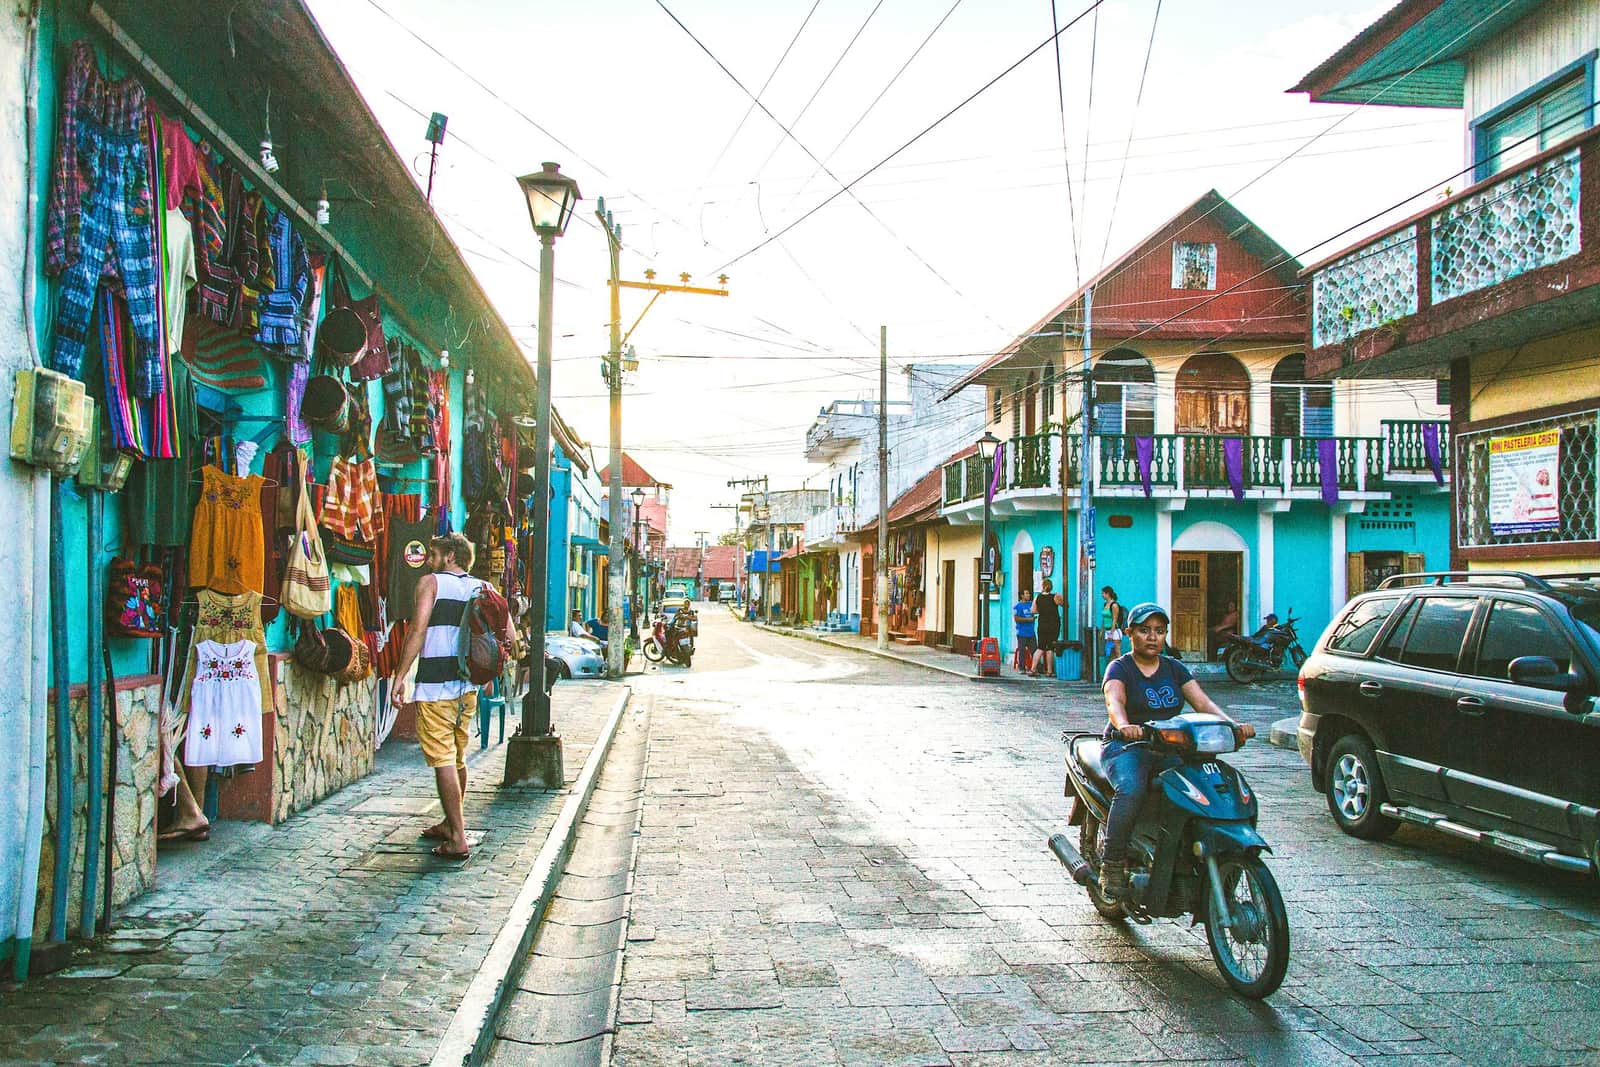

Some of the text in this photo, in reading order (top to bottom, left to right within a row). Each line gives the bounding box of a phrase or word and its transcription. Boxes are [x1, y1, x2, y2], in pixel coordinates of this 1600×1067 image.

[1504, 435, 1536, 449] PASTELERIA
[1538, 431, 1559, 445] CRISTY
[1145, 685, 1179, 709] 92
[1202, 762, 1221, 775] 071
